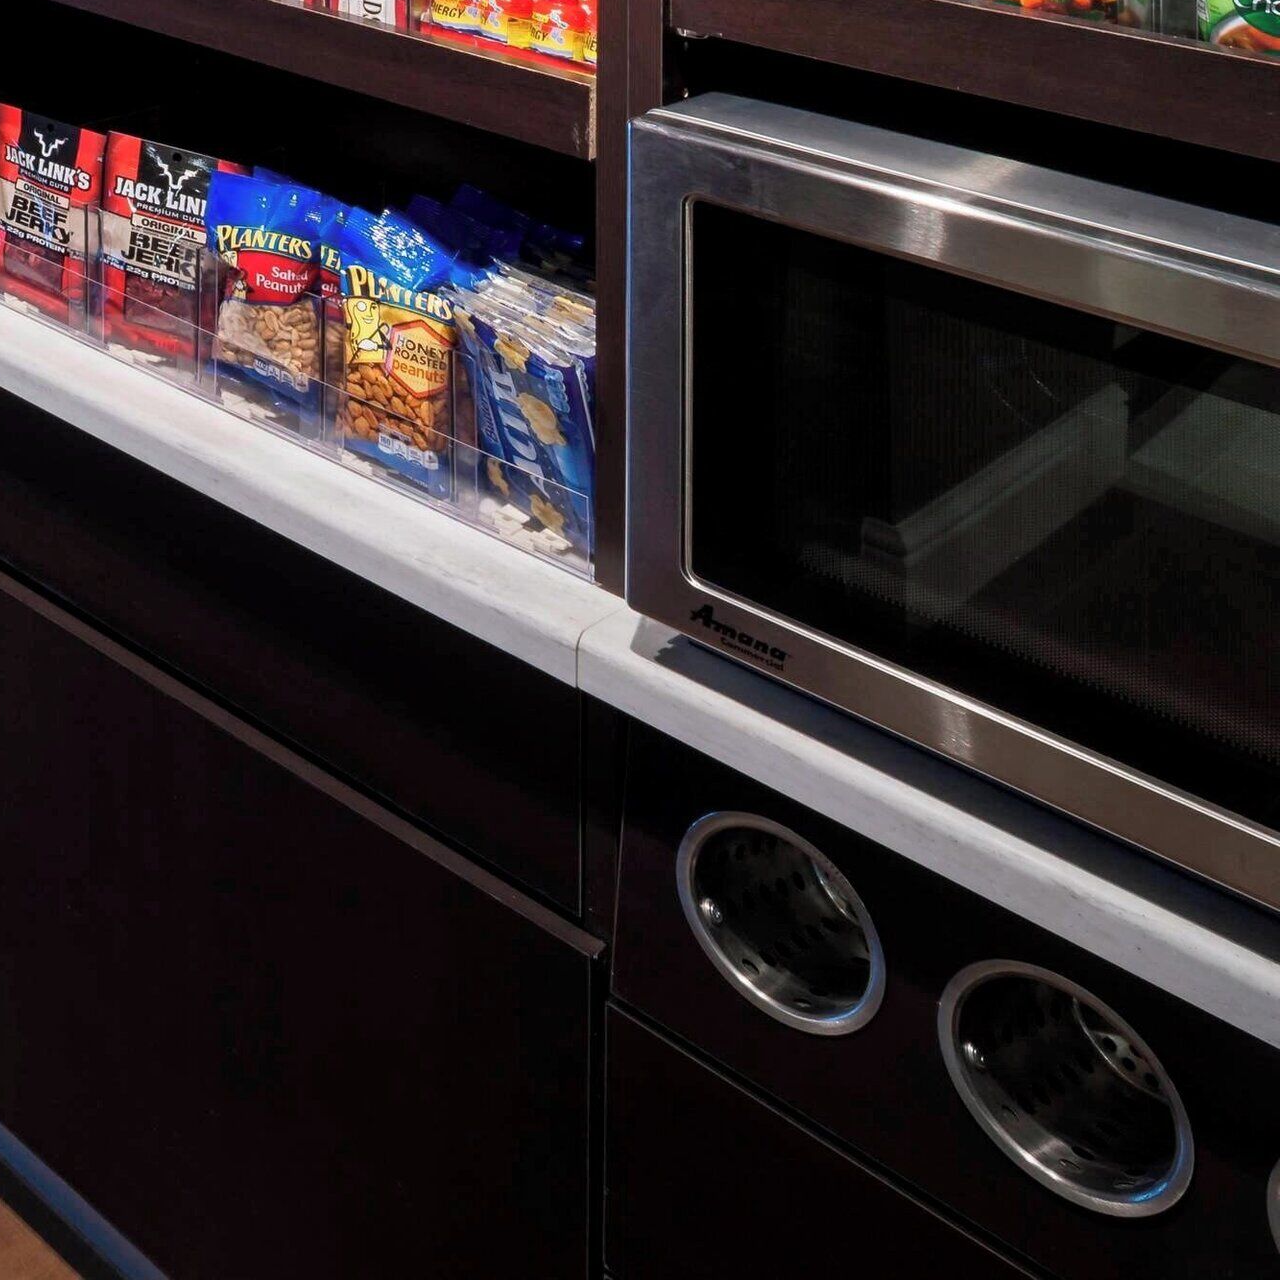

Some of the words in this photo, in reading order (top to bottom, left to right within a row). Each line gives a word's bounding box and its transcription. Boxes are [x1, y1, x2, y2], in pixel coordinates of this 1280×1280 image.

[6, 144, 36, 171] JACK
[38, 158, 90, 190] LINK'S
[23, 183, 61, 205] ORIGINAL
[49, 180, 69, 192] CUTS
[115, 177, 161, 205] JACK
[12, 195, 68, 225] BEEF
[136, 203, 179, 219] PREMIUM
[5, 209, 71, 245] JERKY
[7, 225, 24, 238] 22g
[26, 234, 65, 253] PROTEIN
[142, 218, 198, 240] ORIGINAL
[131, 231, 196, 263] BEEF
[217, 224, 312, 260] PLANTERS
[126, 265, 149, 278] 22g
[271, 267, 308, 281] Salted
[349, 265, 453, 321] PLANTERS
[394, 348, 446, 370] ROASTED
[395, 335, 447, 360] HONEY
[392, 358, 446, 384] peanuts
[691, 604, 789, 662] Amana
[720, 637, 784, 671] Commercial
